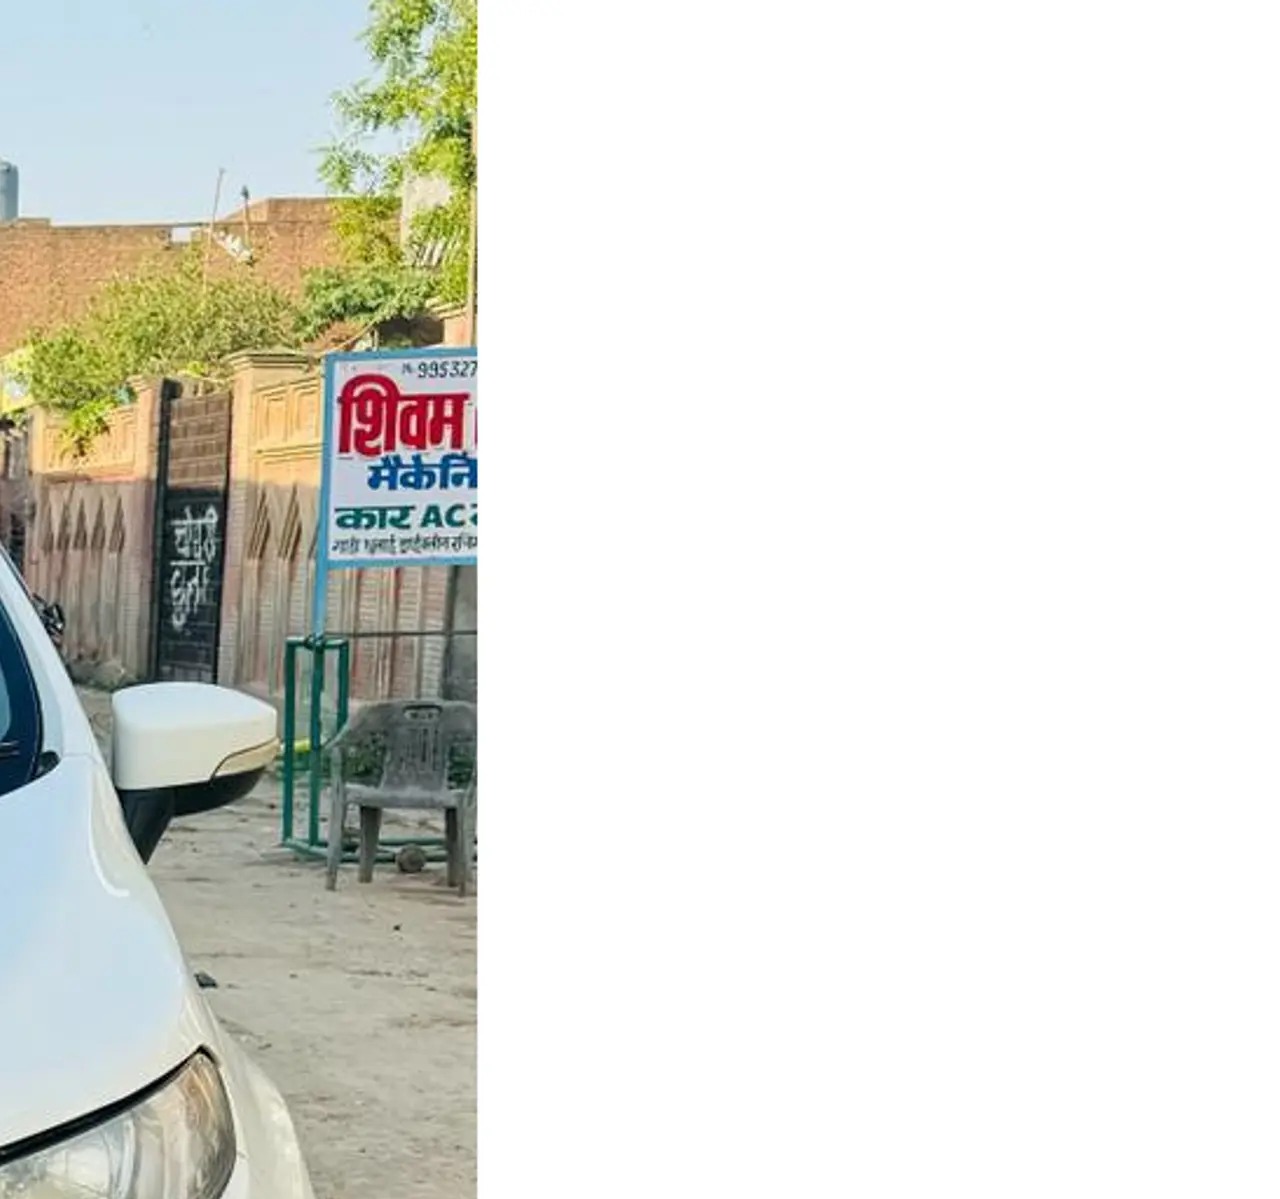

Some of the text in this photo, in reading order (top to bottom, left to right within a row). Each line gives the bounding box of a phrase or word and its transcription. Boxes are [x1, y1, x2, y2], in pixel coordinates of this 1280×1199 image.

[337, 374, 470, 457] शिवम
[335, 504, 416, 529] कार
[420, 504, 466, 528] AC
